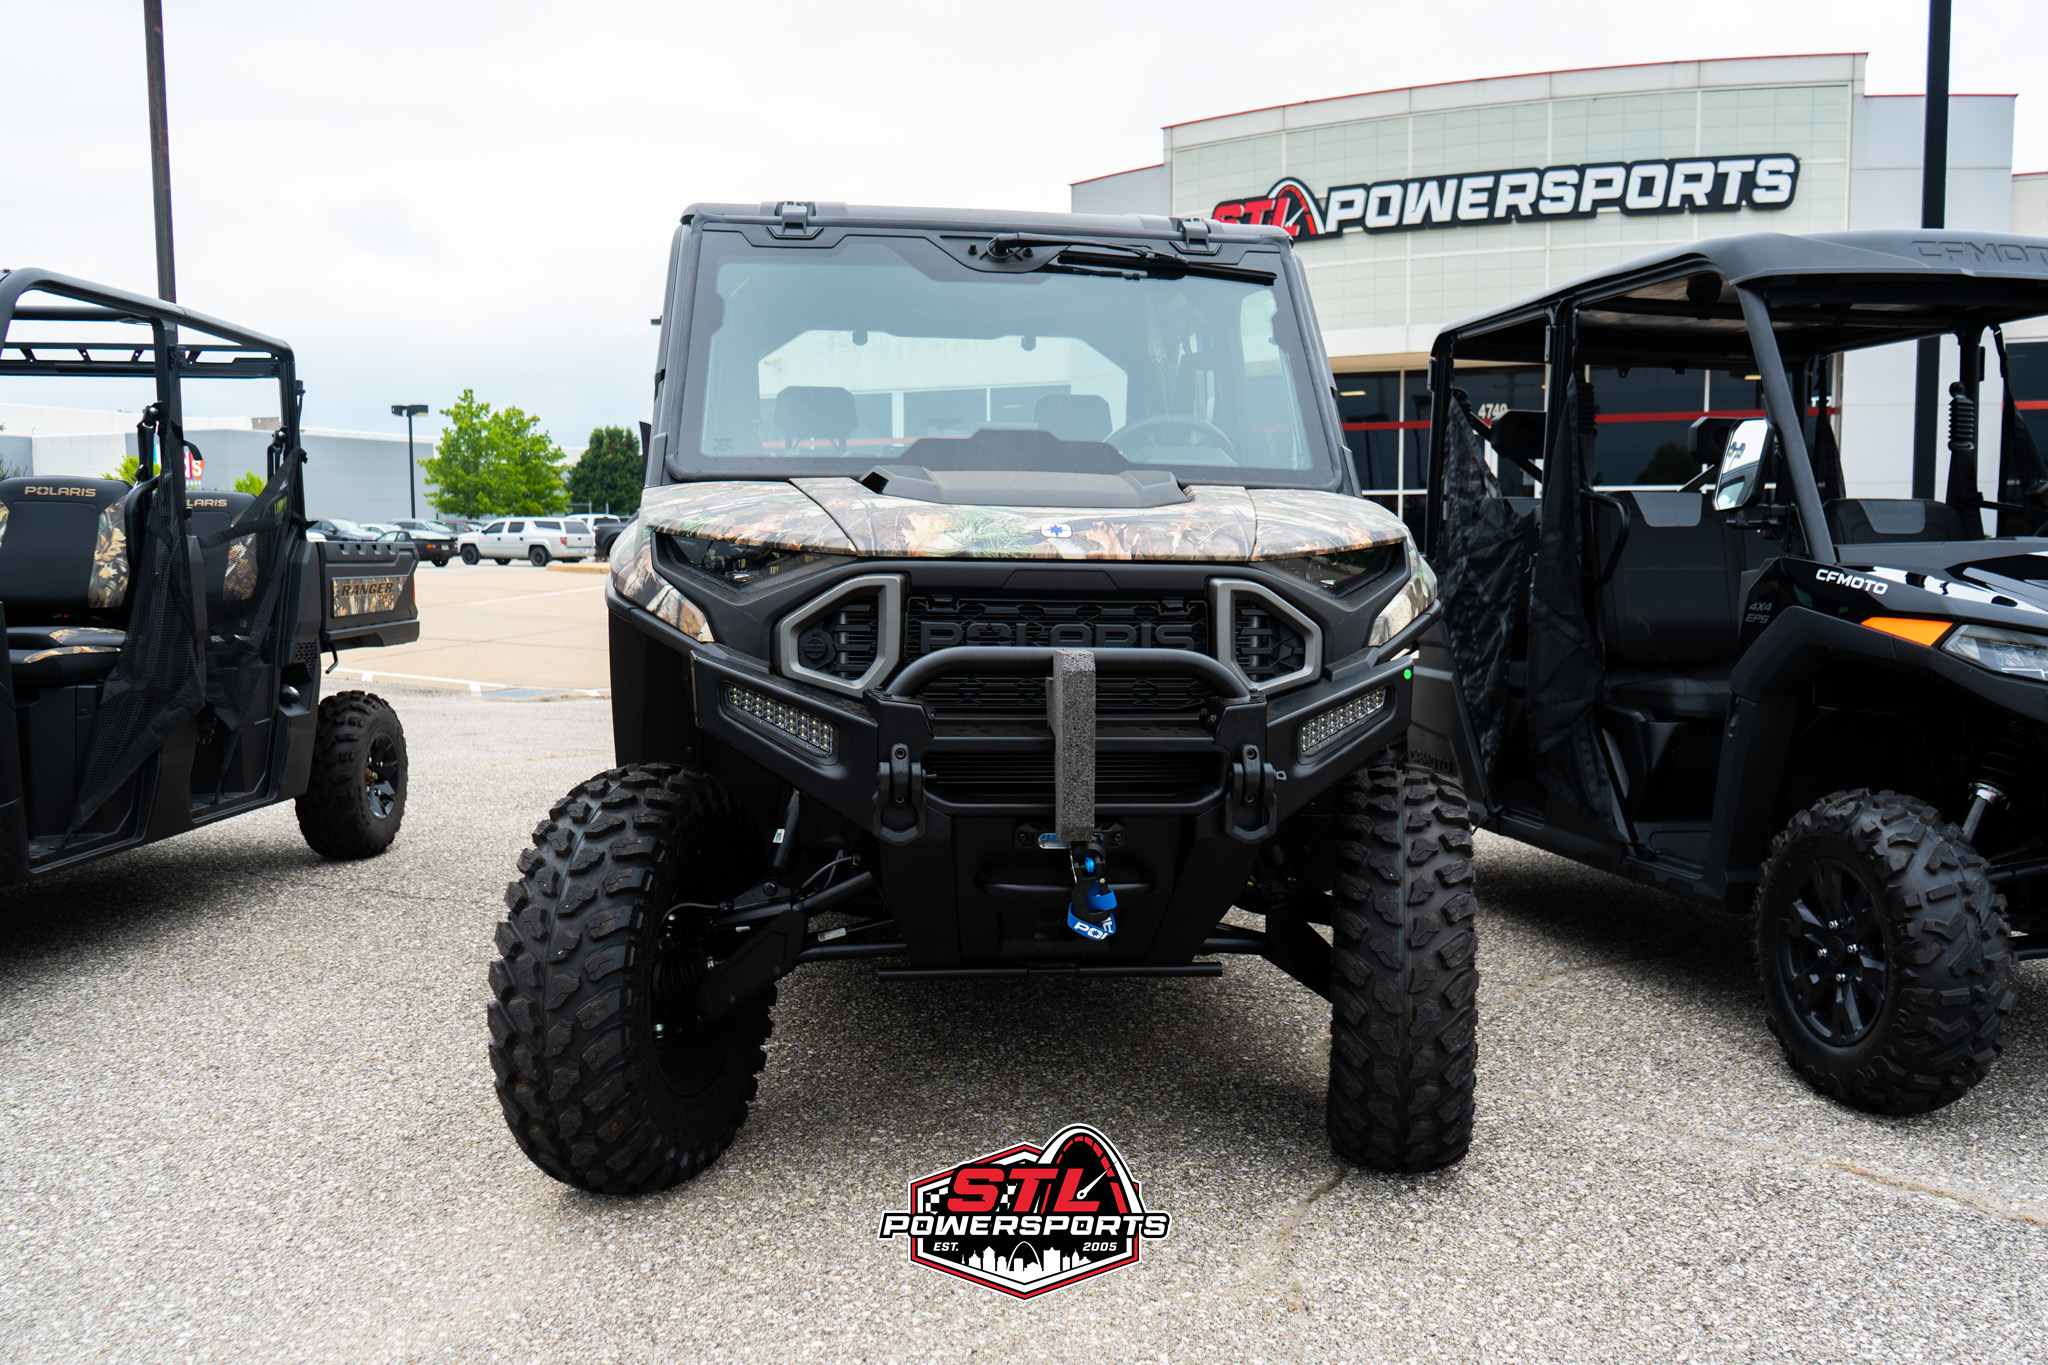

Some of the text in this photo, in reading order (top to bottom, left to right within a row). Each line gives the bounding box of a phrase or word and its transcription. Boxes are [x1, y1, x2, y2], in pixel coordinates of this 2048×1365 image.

[1326, 158, 1795, 232] POWERSPORTS
[24, 486, 97, 498] POLARIS
[186, 499, 228, 507] LARIS
[1815, 568, 1889, 595] CFMOTO
[340, 582, 394, 598] RANGER
[1749, 602, 1773, 612] 4X4
[1745, 613, 1770, 624] EPS
[919, 621, 1196, 652] POLARIS
